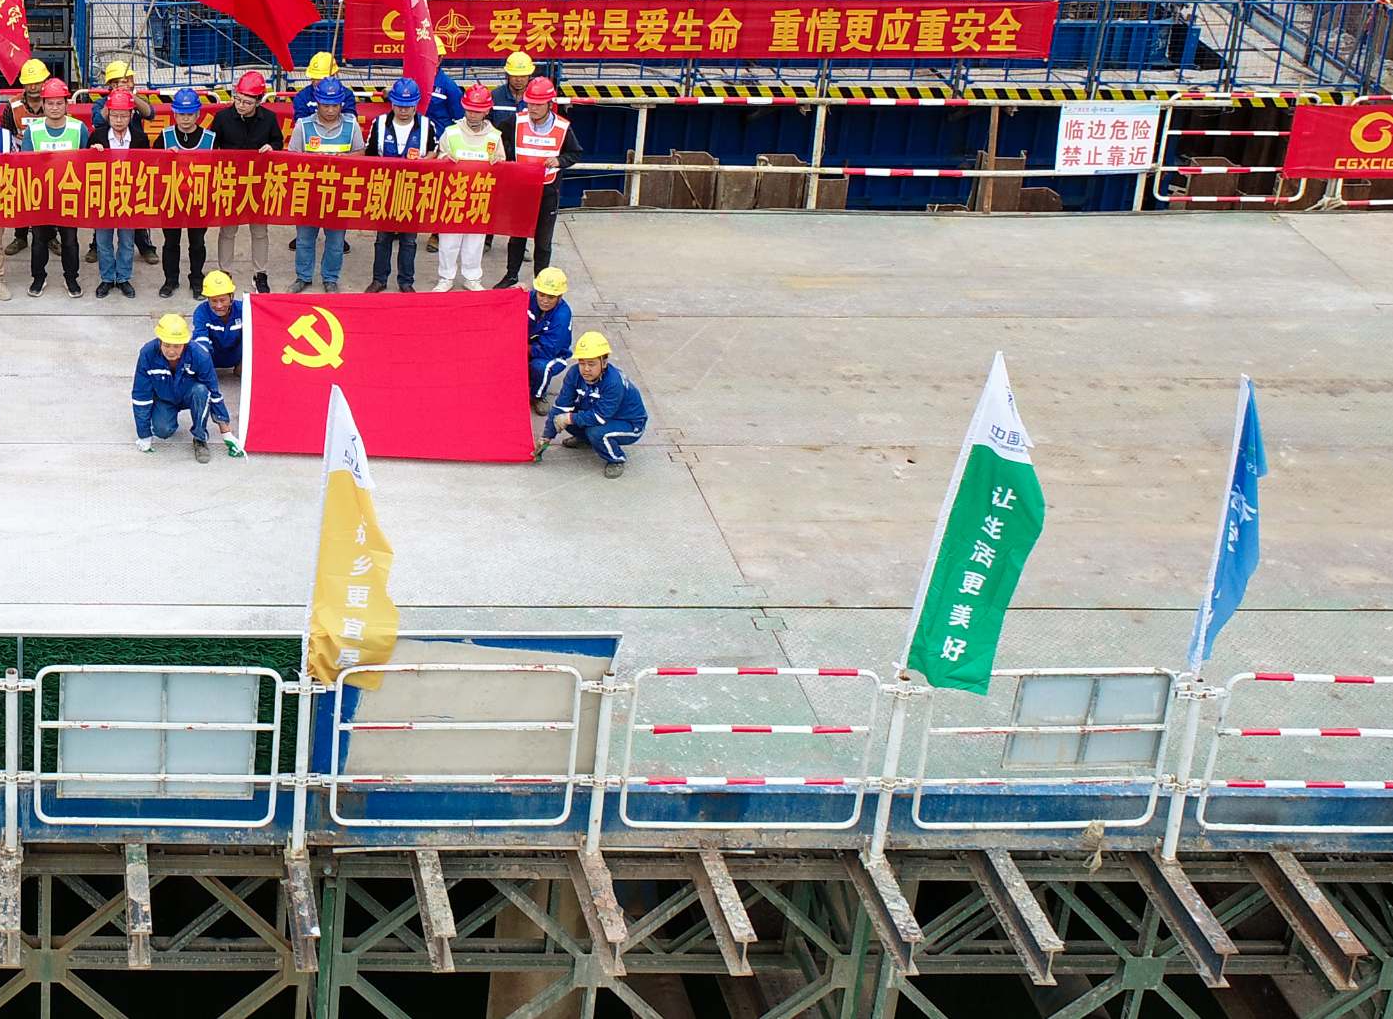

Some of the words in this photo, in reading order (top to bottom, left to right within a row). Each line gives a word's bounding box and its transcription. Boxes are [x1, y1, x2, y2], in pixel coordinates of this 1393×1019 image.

[488, 7, 743, 53] 爱家就是爱生命
[769, 7, 1022, 53] 重情更应重安全
[1064, 119, 1151, 140] 临边危险
[1062, 145, 1148, 166] 禁止靠近
[940, 486, 1017, 662] 让生活更美好
